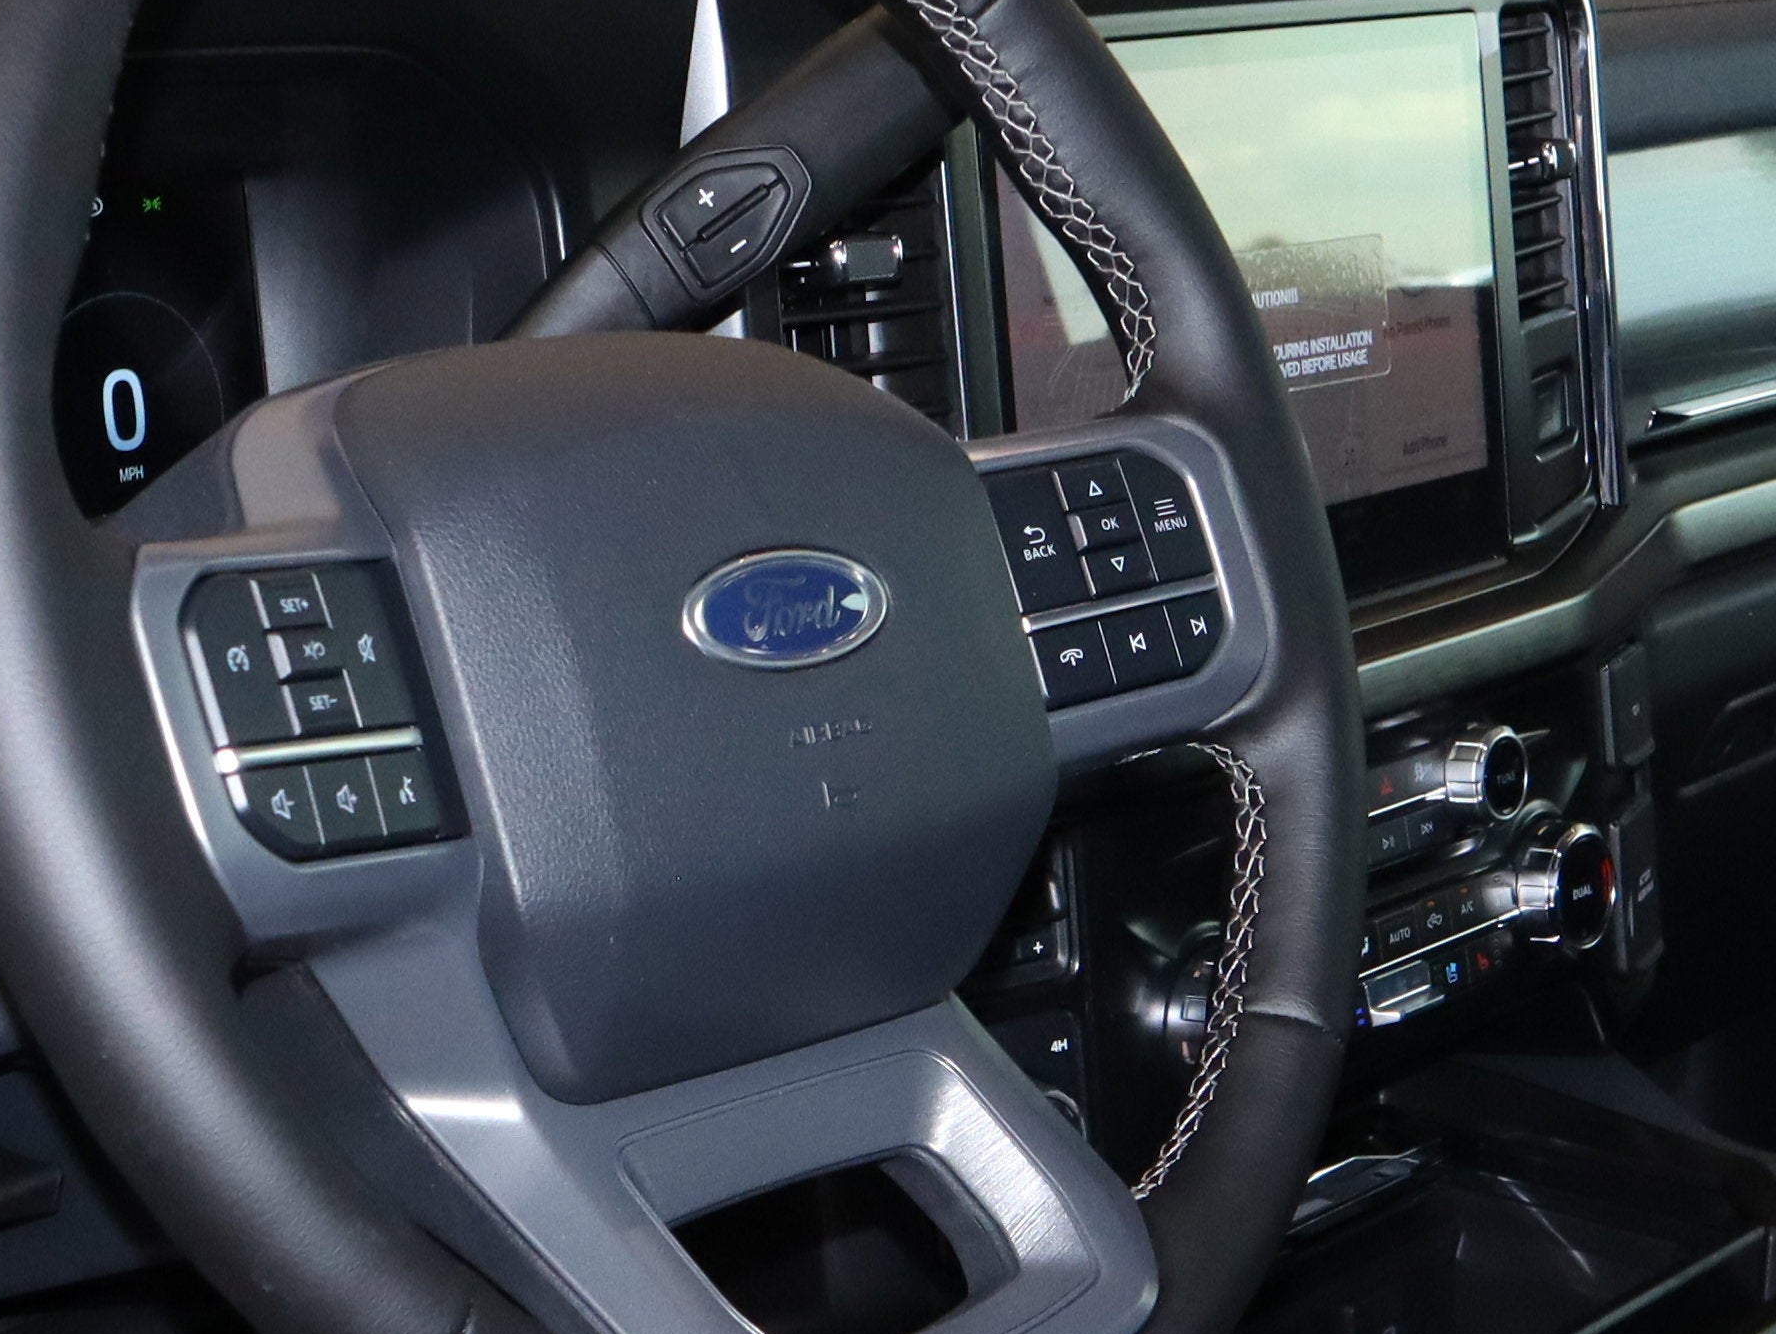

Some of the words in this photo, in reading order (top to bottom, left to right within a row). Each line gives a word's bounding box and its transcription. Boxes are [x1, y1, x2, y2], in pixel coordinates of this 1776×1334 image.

[1310, 330, 1373, 355] INSTALLATION
[1301, 354, 1338, 376] BEFORE
[1337, 348, 1368, 369] USAGE
[102, 368, 146, 452] 0
[119, 465, 145, 483] MPH
[1101, 519, 1120, 531] OK
[1154, 516, 1188, 533] MENU
[1023, 544, 1057, 561] BACK
[1389, 926, 1411, 944] AUTO
[1050, 1039, 1069, 1053] 4H
